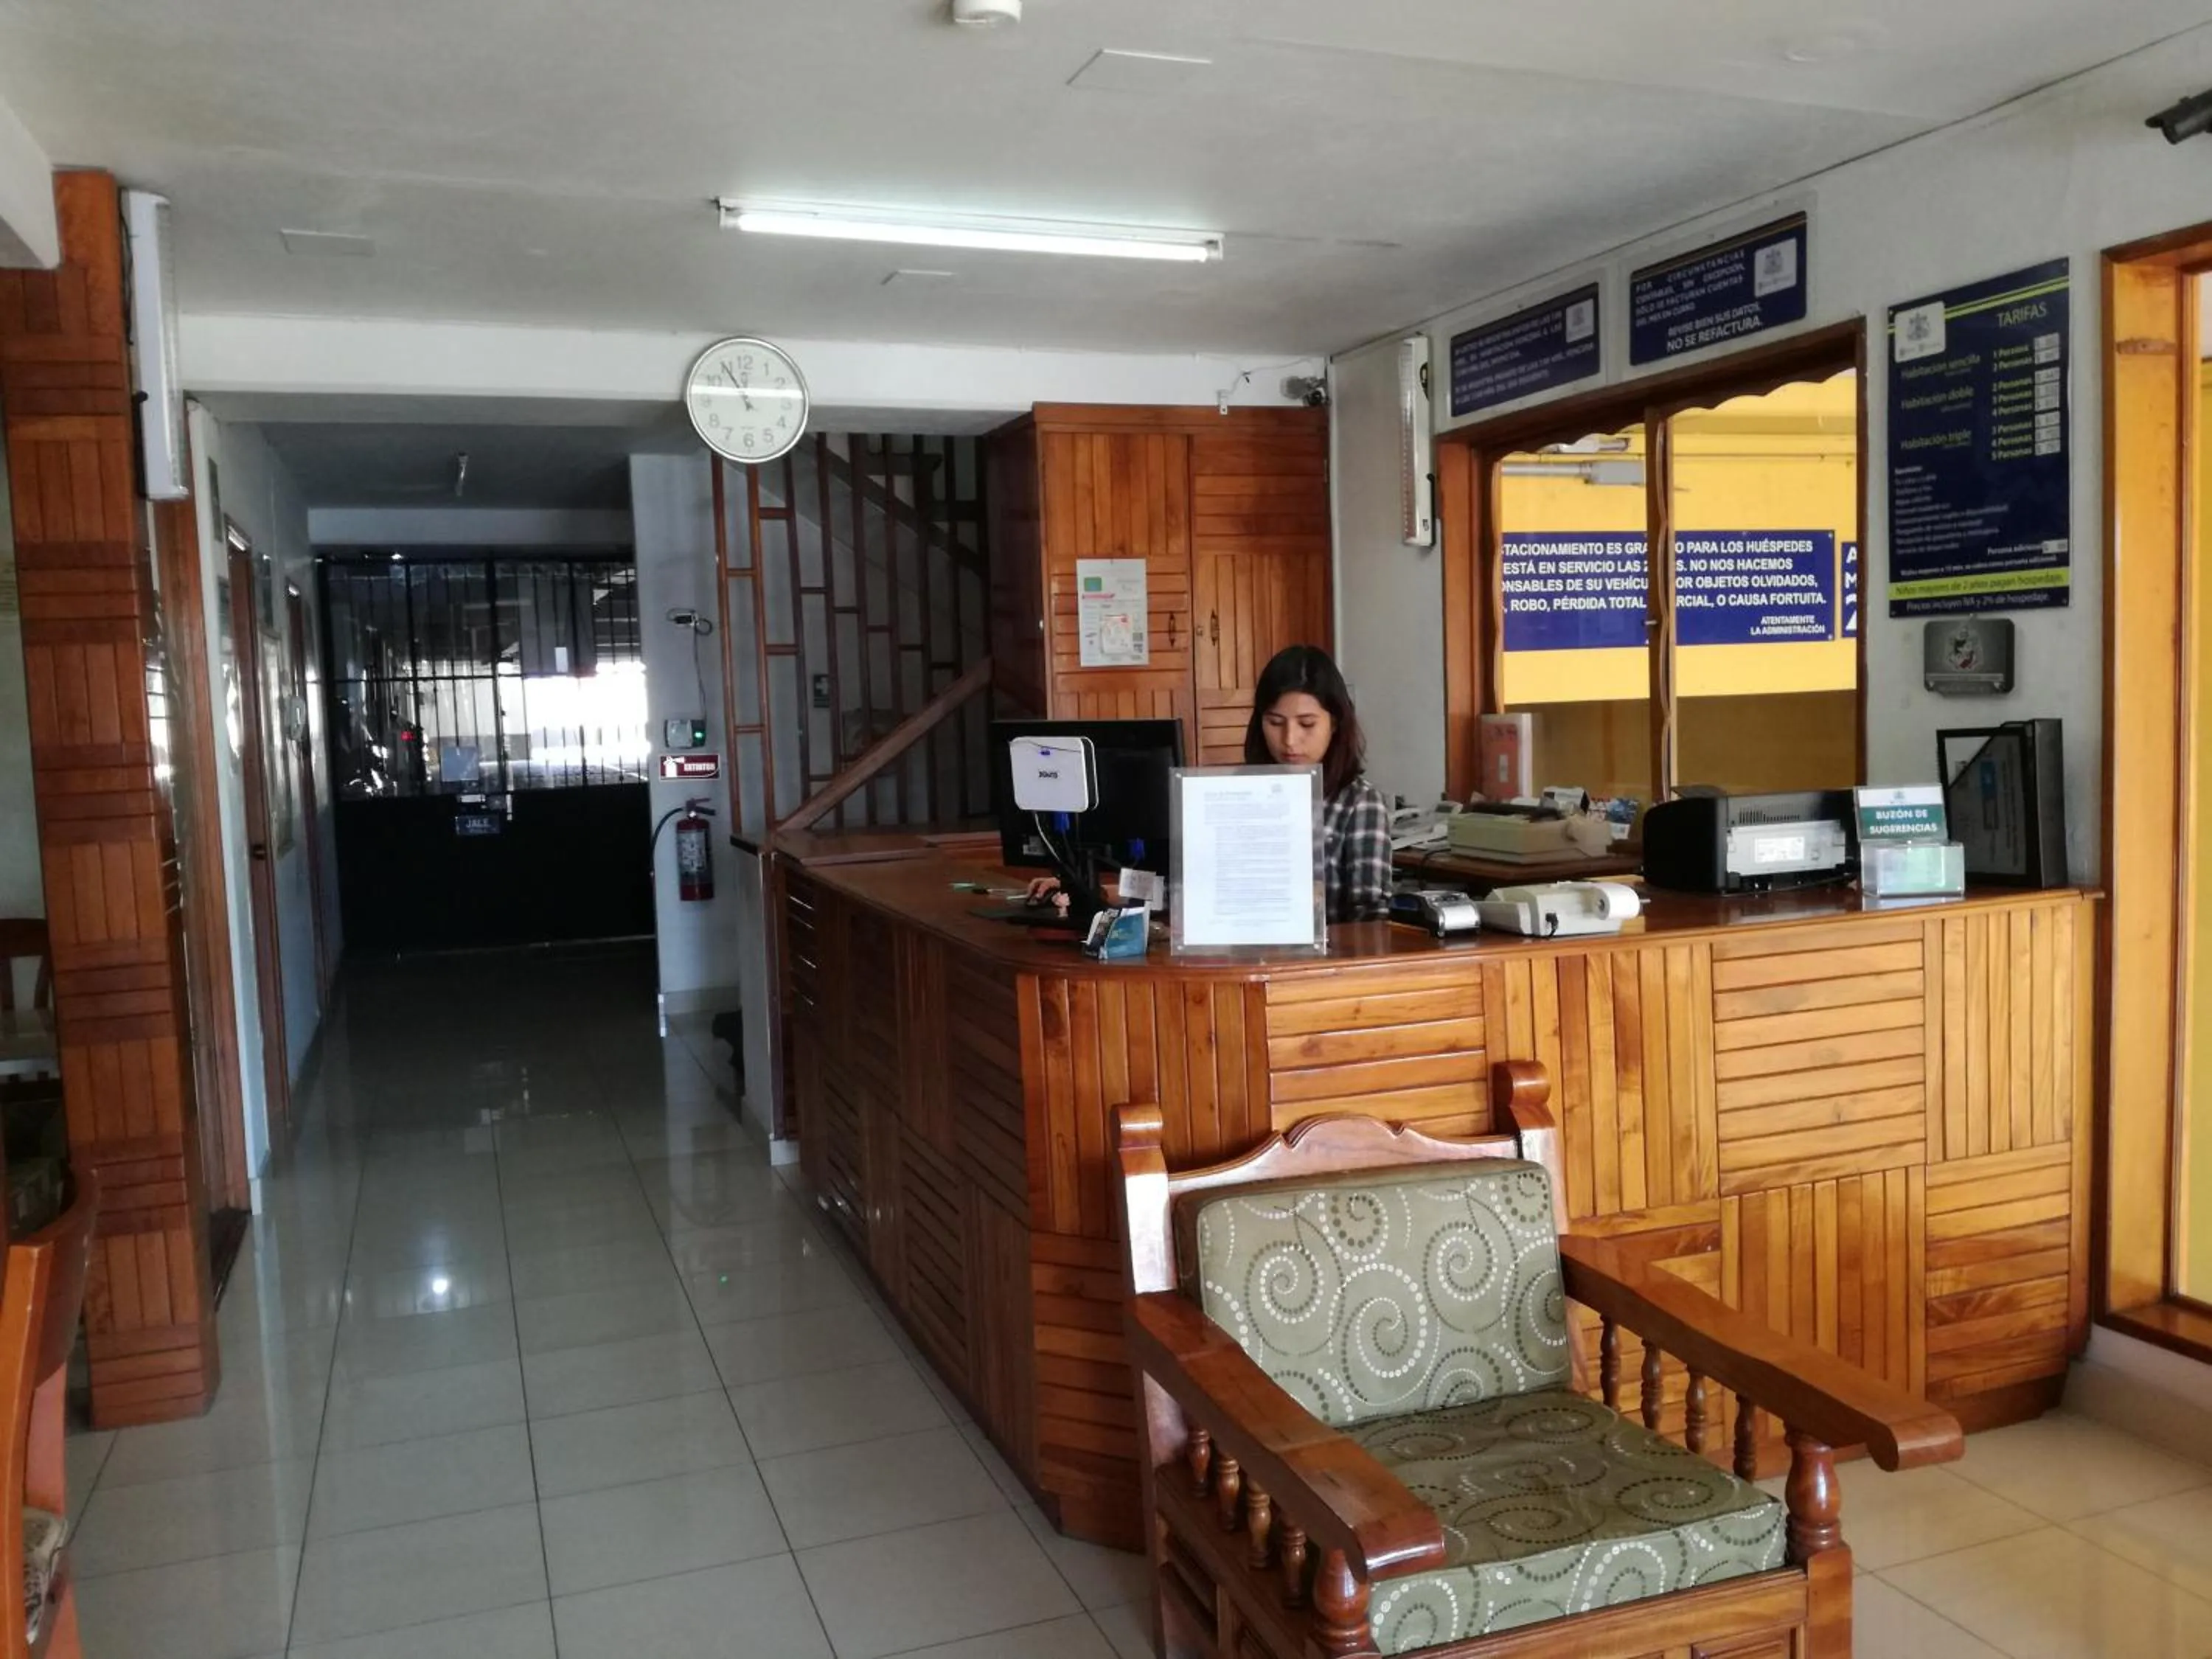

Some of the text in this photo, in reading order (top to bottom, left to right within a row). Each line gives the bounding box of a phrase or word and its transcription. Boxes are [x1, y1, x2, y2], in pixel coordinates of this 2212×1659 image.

[1997, 302, 2047, 327] TARIFAS
[1666, 338, 1683, 352] NO
[1685, 333, 1697, 347] SE
[737, 355, 754, 370] 12
[776, 417, 786, 428] 4
[723, 427, 734, 440] 7
[763, 428, 773, 442] 5
[743, 434, 754, 448] 6
[1502, 542, 1604, 555] TACIONAMIENTO
[1607, 542, 1622, 554] ES
[1687, 541, 1718, 553] PARA
[1721, 541, 1743, 552] LOS
[1746, 538, 1813, 552] HUÉSPEDES
[1503, 560, 1536, 574] ESTÁ
[1539, 562, 1556, 574] EN
[1558, 561, 1615, 574] SERVICIO
[1617, 560, 1641, 572] LAS
[1690, 559, 1707, 571] NO
[1710, 558, 1735, 571] NOS
[1737, 557, 1793, 570] HACEMOS
[1566, 579, 1583, 591] DE
[1585, 579, 1602, 591] SU
[1604, 575, 1649, 591] VEHÍCU
[1675, 577, 1693, 588] OR
[1695, 576, 1749, 588] OBJETOS
[1751, 575, 1818, 588] OLVIDADOS,
[1510, 592, 1826, 612] ROBO, PÉRDIDA TOTAL RCIAL, O CAUSA FORTUITA.
[1761, 615, 1815, 625] ATENTAMENTE
[1750, 627, 1761, 635] LA
[1875, 808, 1928, 820] BUZÓN DE
[1869, 822, 1938, 835] SUGERENCIAS
